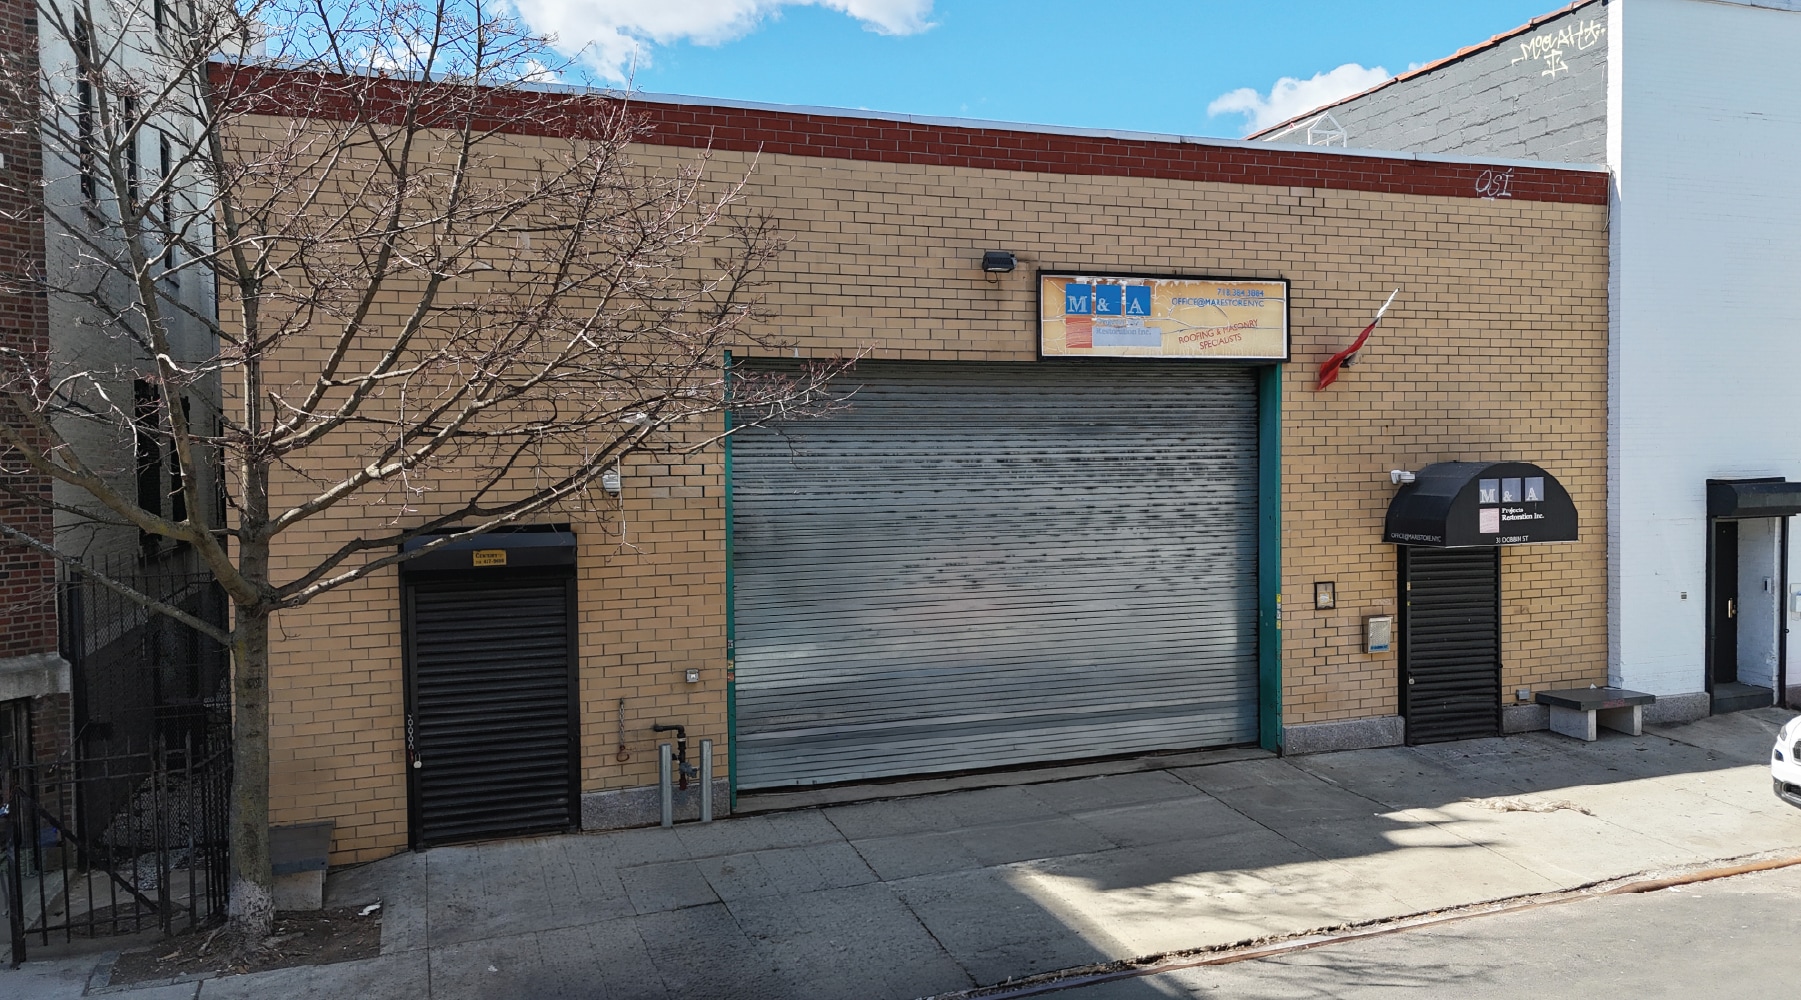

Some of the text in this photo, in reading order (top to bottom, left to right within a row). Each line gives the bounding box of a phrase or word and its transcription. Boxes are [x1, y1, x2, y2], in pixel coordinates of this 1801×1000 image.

[1067, 295, 1144, 314] M & A
[1178, 319, 1259, 345] ROOFING & MASONRY
[1200, 333, 1242, 350] SPECIALISTS
[1480, 487, 1539, 503] M & A
[1501, 512, 1545, 521] Restoration Inc.
